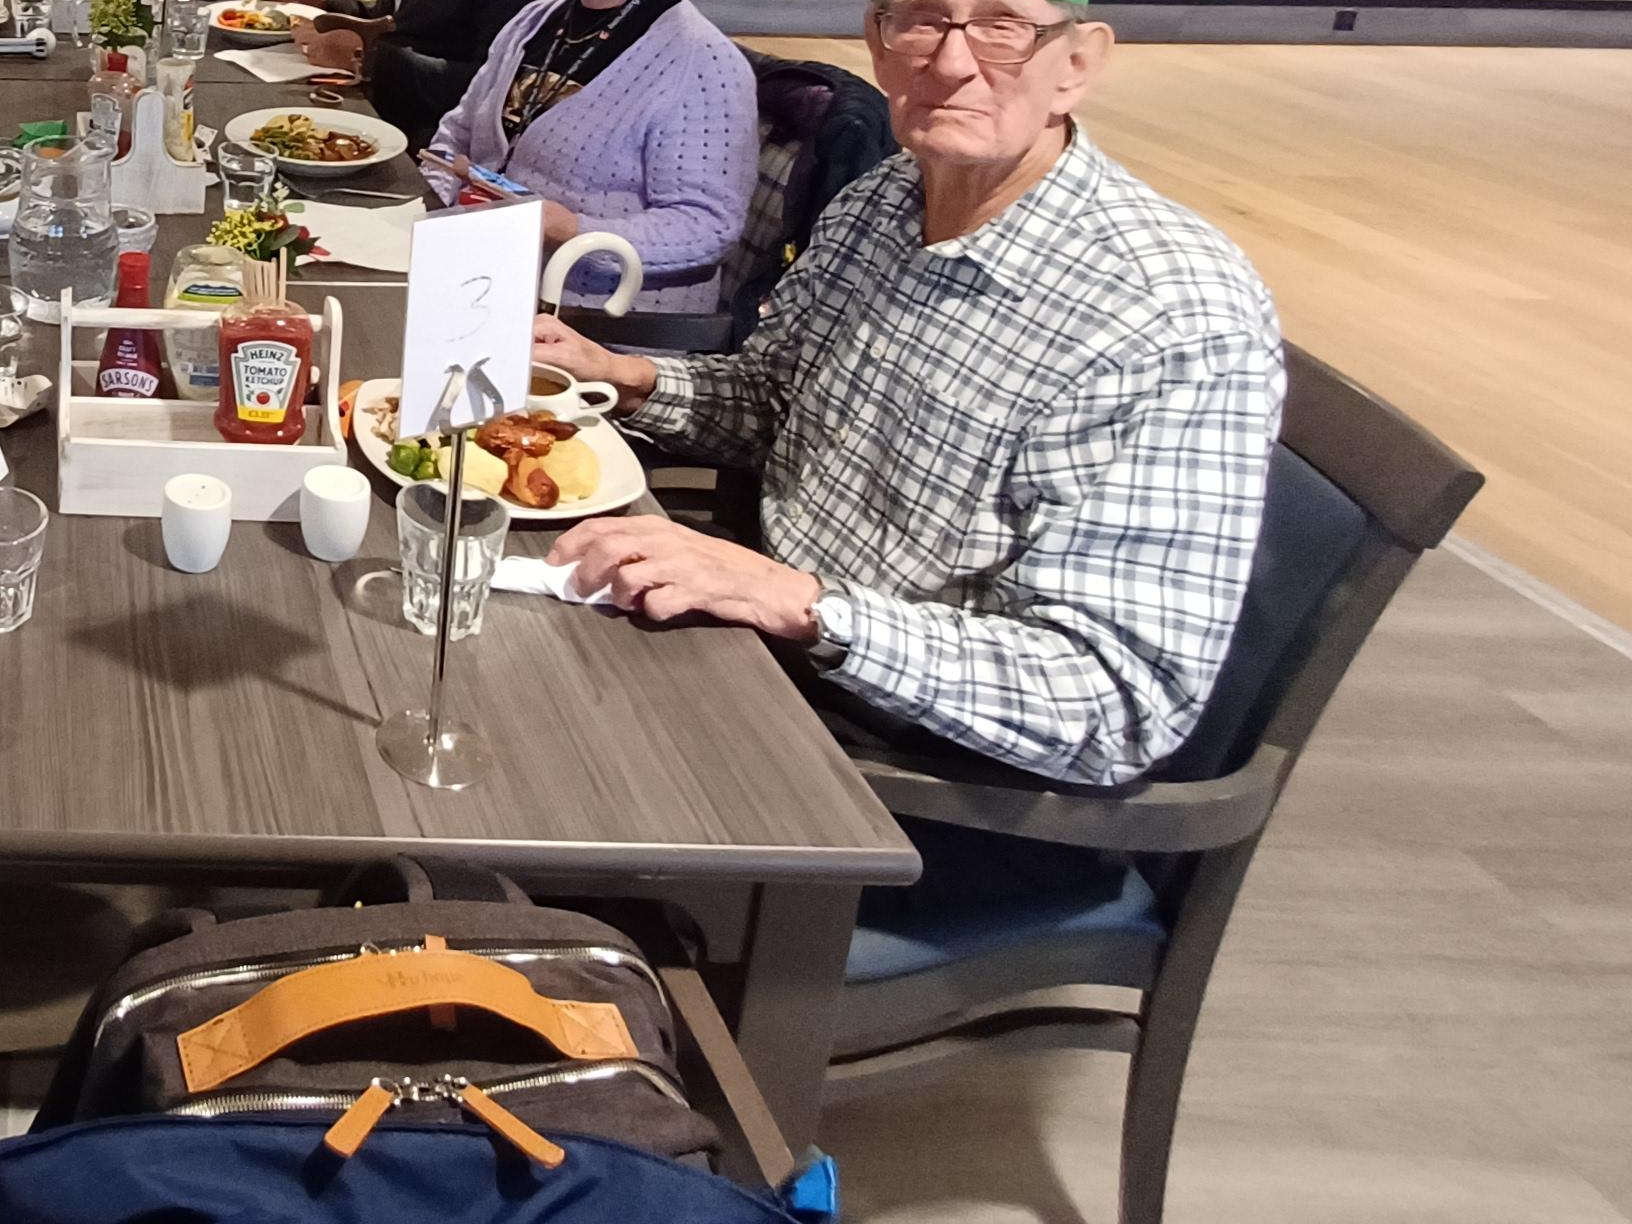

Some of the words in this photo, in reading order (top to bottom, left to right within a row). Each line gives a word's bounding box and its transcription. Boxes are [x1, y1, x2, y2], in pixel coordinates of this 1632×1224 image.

[445, 275, 493, 342] 3
[250, 349, 284, 362] HEINZ
[244, 365, 288, 377] TOMATO
[245, 376, 285, 385] KETCHUP
